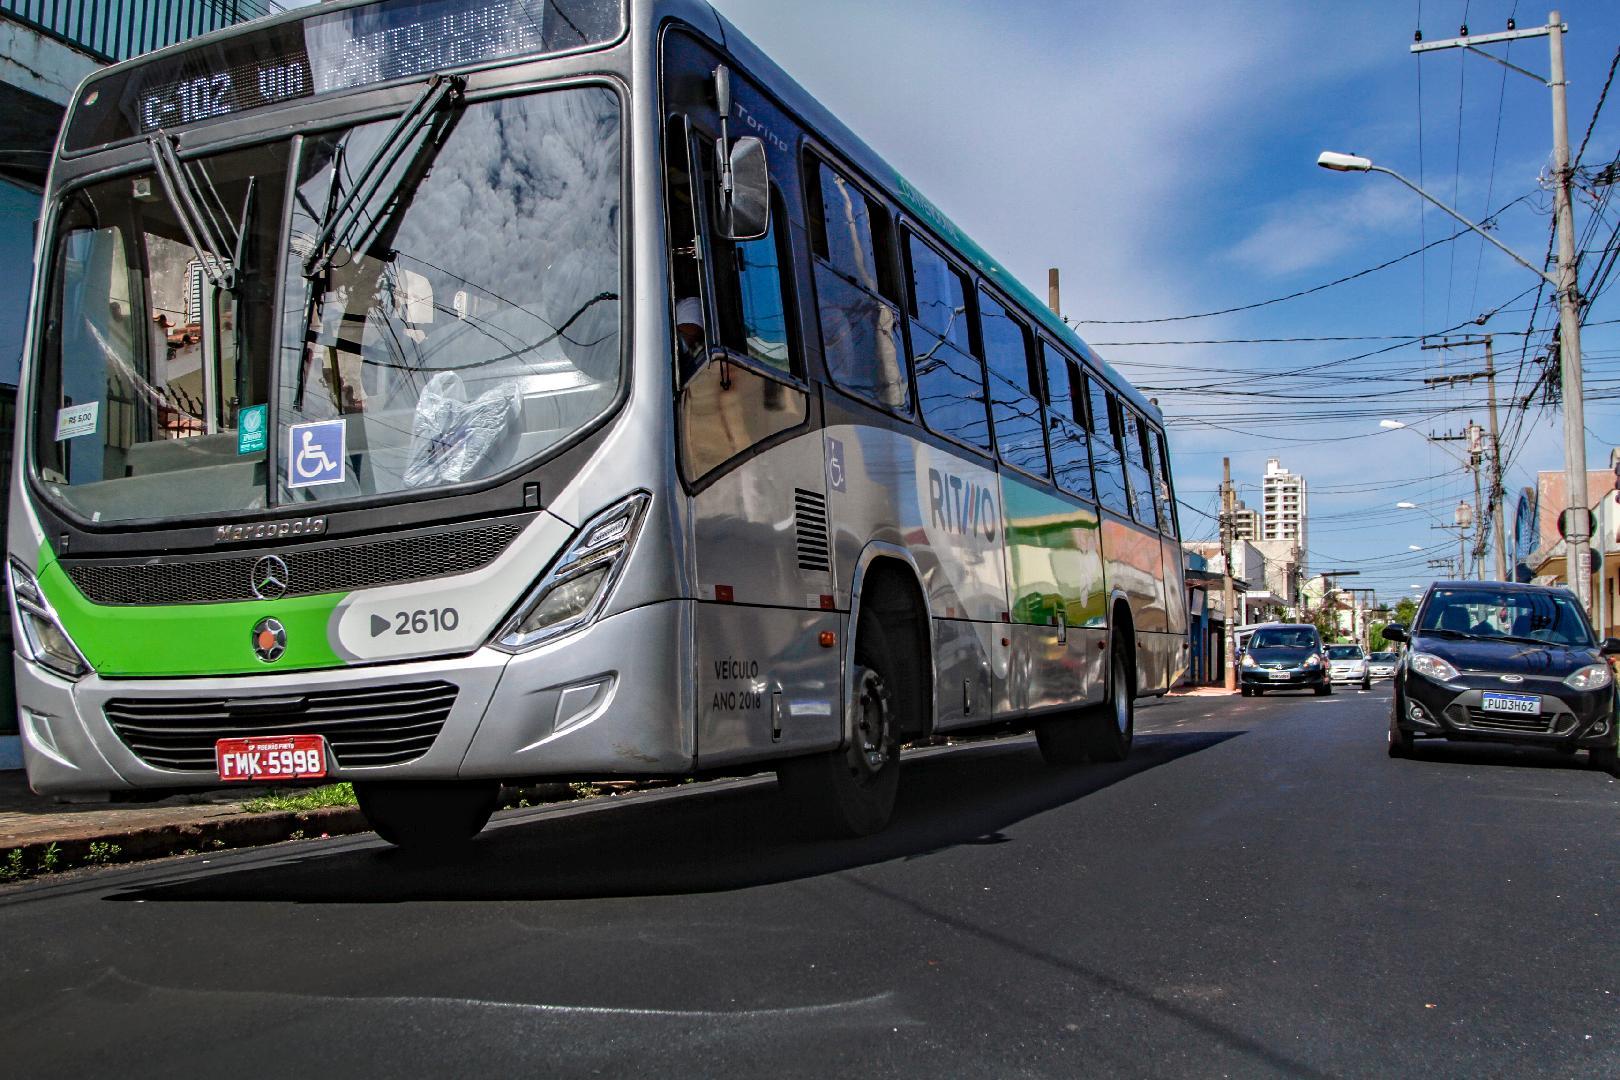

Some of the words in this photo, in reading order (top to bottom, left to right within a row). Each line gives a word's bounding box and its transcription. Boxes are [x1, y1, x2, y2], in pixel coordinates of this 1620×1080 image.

[734, 102, 788, 152] Torino
[215, 517, 324, 541] Marcopolo
[395, 607, 459, 635] 2610
[714, 656, 759, 680] VEÍCULO
[712, 692, 736, 712] ANO
[739, 692, 761, 710] 2018
[1488, 699, 1534, 712] PUD3H62
